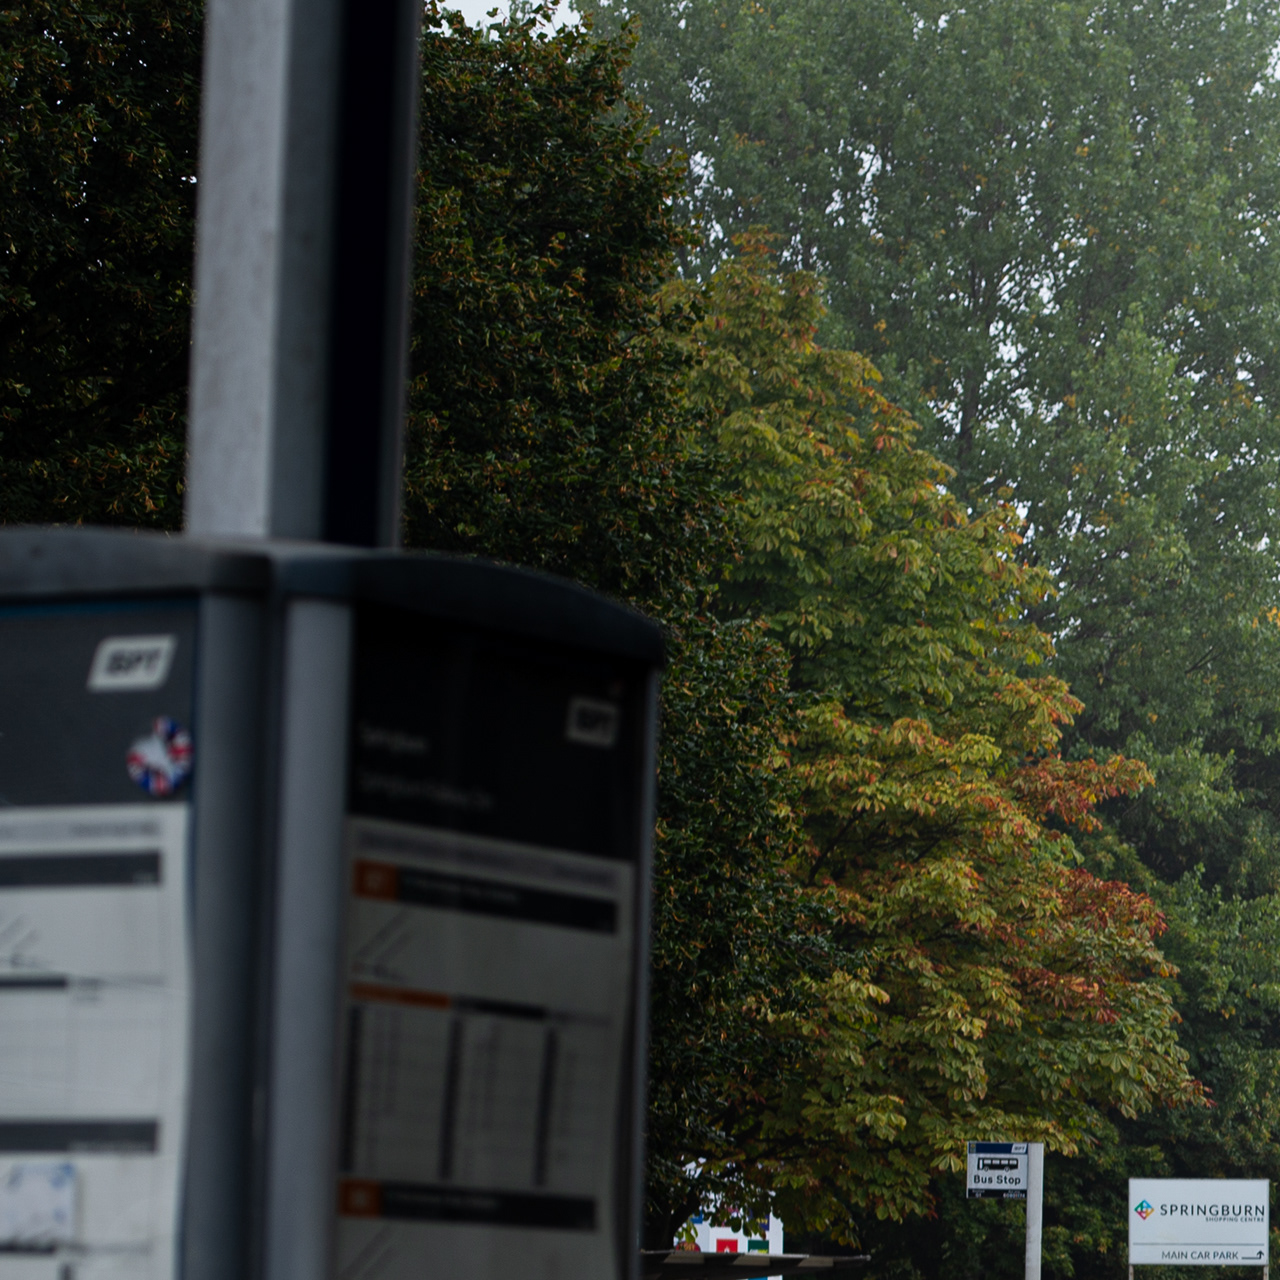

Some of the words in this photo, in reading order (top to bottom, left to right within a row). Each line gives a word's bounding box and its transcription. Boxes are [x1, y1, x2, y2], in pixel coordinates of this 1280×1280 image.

[973, 1175, 993, 1184] Bus
[996, 1175, 1021, 1186] Stop
[1160, 1203, 1265, 1217] SPRINGBURN
[1161, 1251, 1188, 1260] MAIN
[1190, 1251, 1210, 1260] CAR
[1213, 1251, 1239, 1261] PARK
